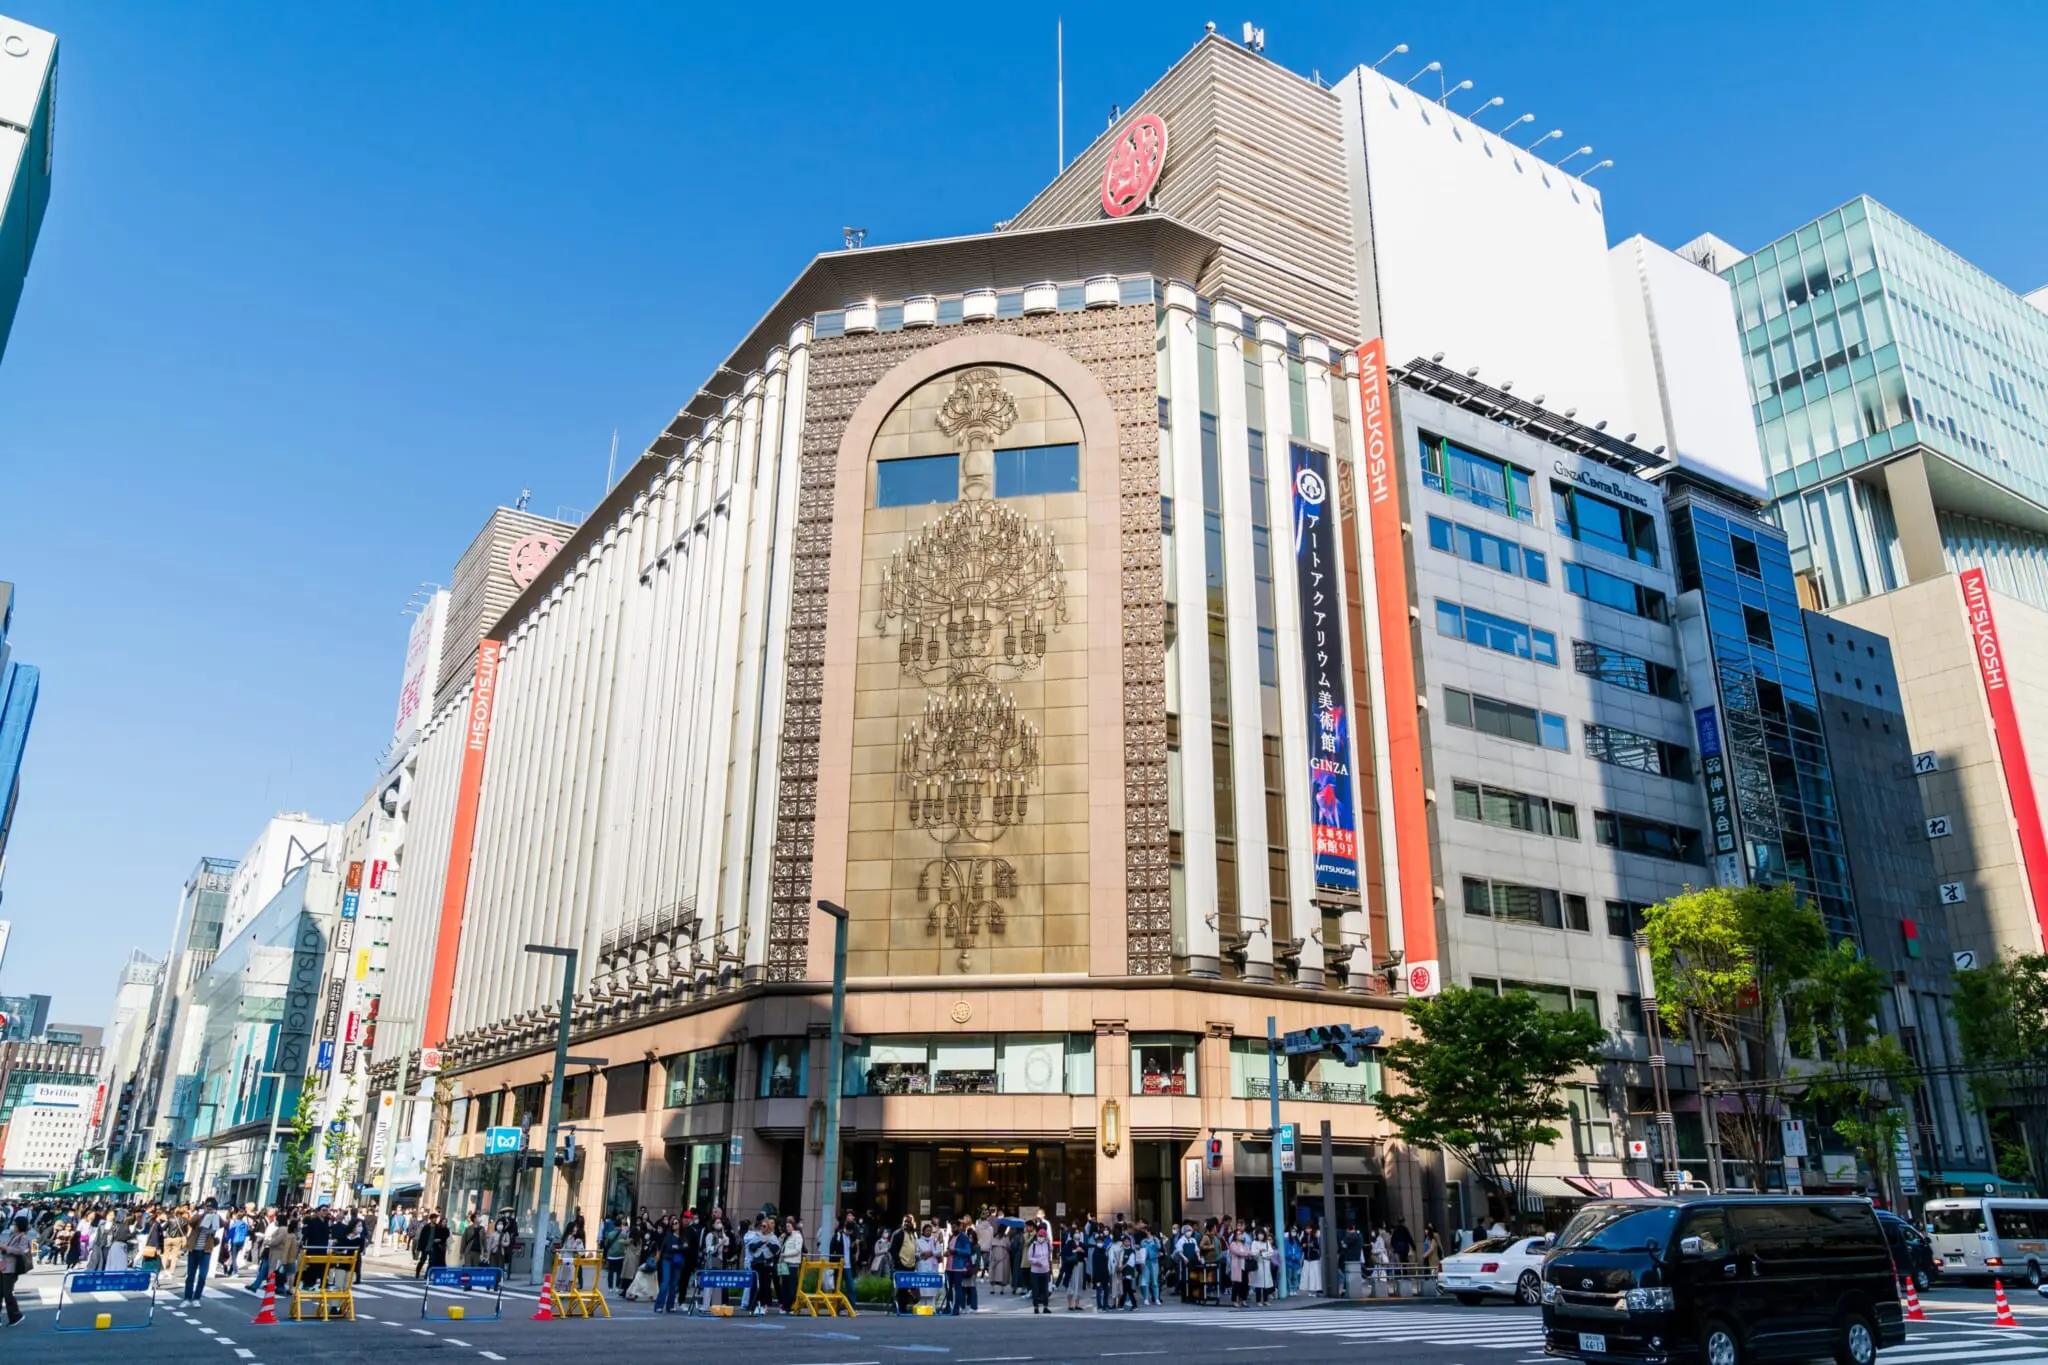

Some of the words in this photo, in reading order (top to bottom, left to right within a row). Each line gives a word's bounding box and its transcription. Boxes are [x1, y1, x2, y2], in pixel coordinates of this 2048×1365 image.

[1362, 351, 1389, 504] MITSUKOSHI
[1307, 513, 1337, 754] アートアクアリウム美術館
[1966, 577, 2004, 690] MITSUKOSHI
[470, 647, 497, 751] MITSUKOSHI
[1310, 757, 1349, 776] GINZA
[1315, 864, 1356, 877] MITSUKOSHI
[40, 1088, 78, 1097] Brillia
